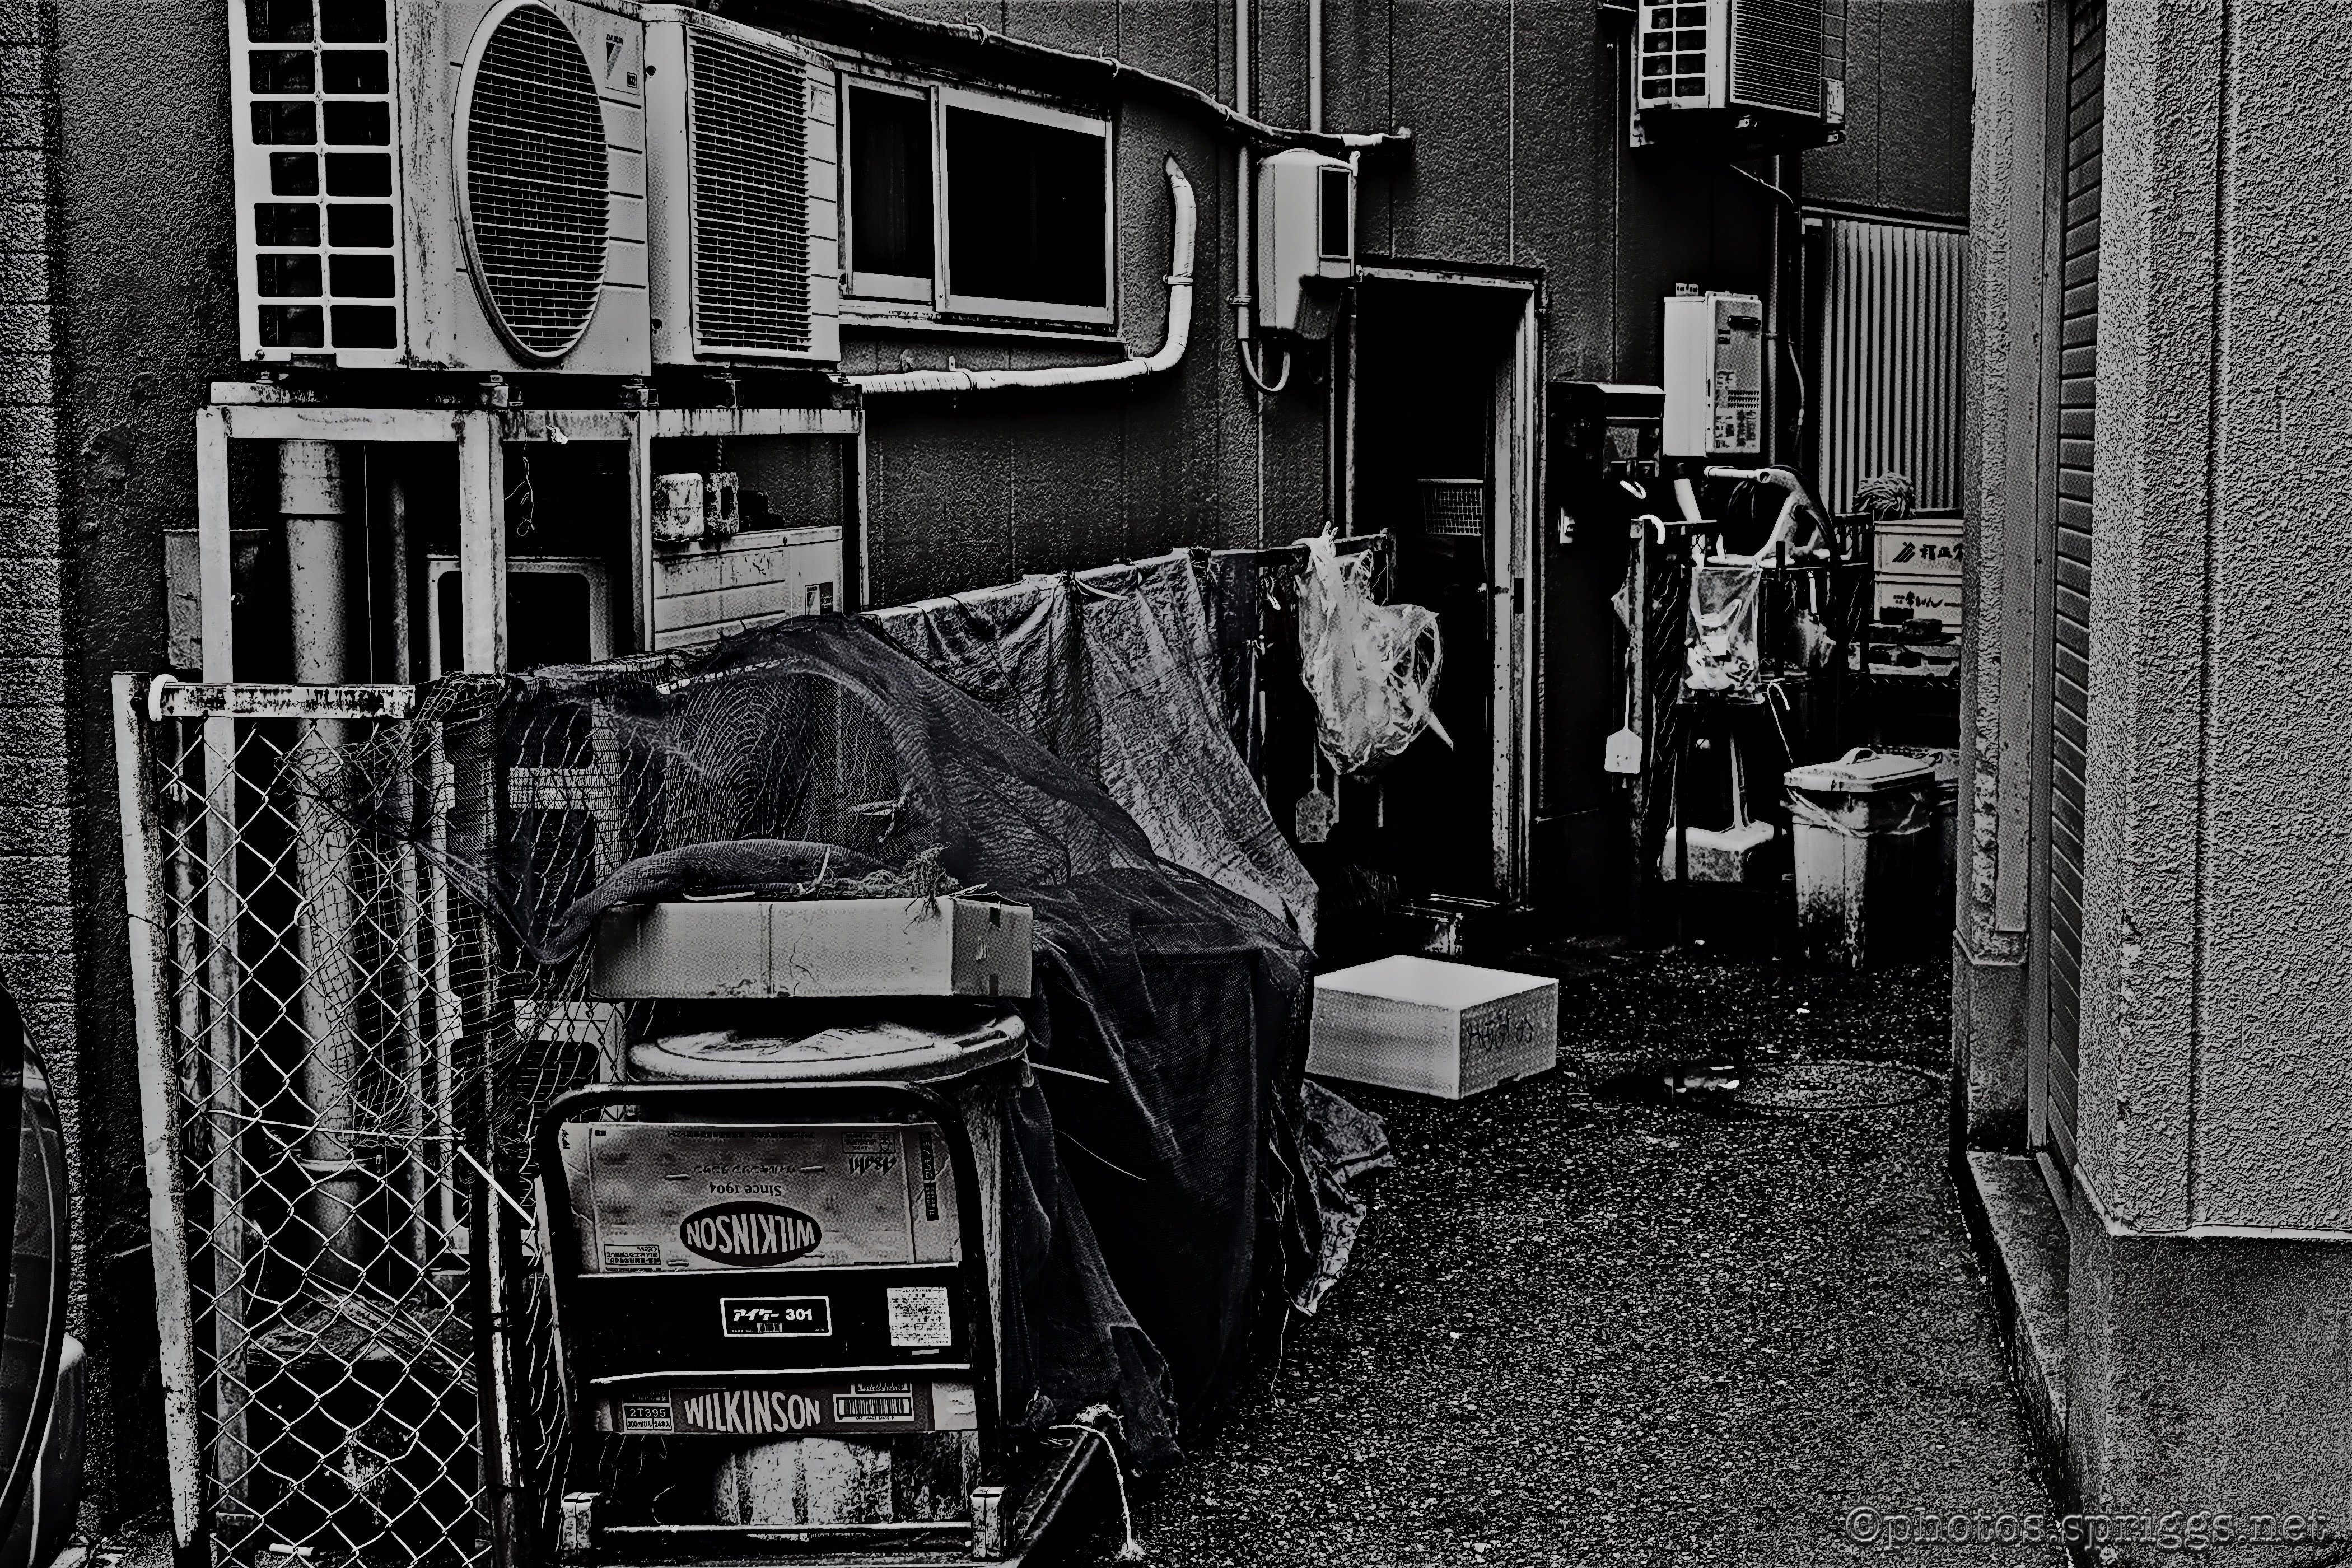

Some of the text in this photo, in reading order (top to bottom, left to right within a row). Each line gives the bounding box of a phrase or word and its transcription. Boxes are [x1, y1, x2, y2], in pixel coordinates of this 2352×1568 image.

[693, 1165, 795, 1174] ウィルキンソン タンサン
[849, 1156, 897, 1175] Asahi
[708, 1182, 782, 1196] Since 1904
[686, 1214, 815, 1254] WILKINSON
[733, 1308, 813, 1322] アイケー 301
[629, 1408, 666, 1417] 2T395
[684, 1390, 820, 1434] WILKINSON
